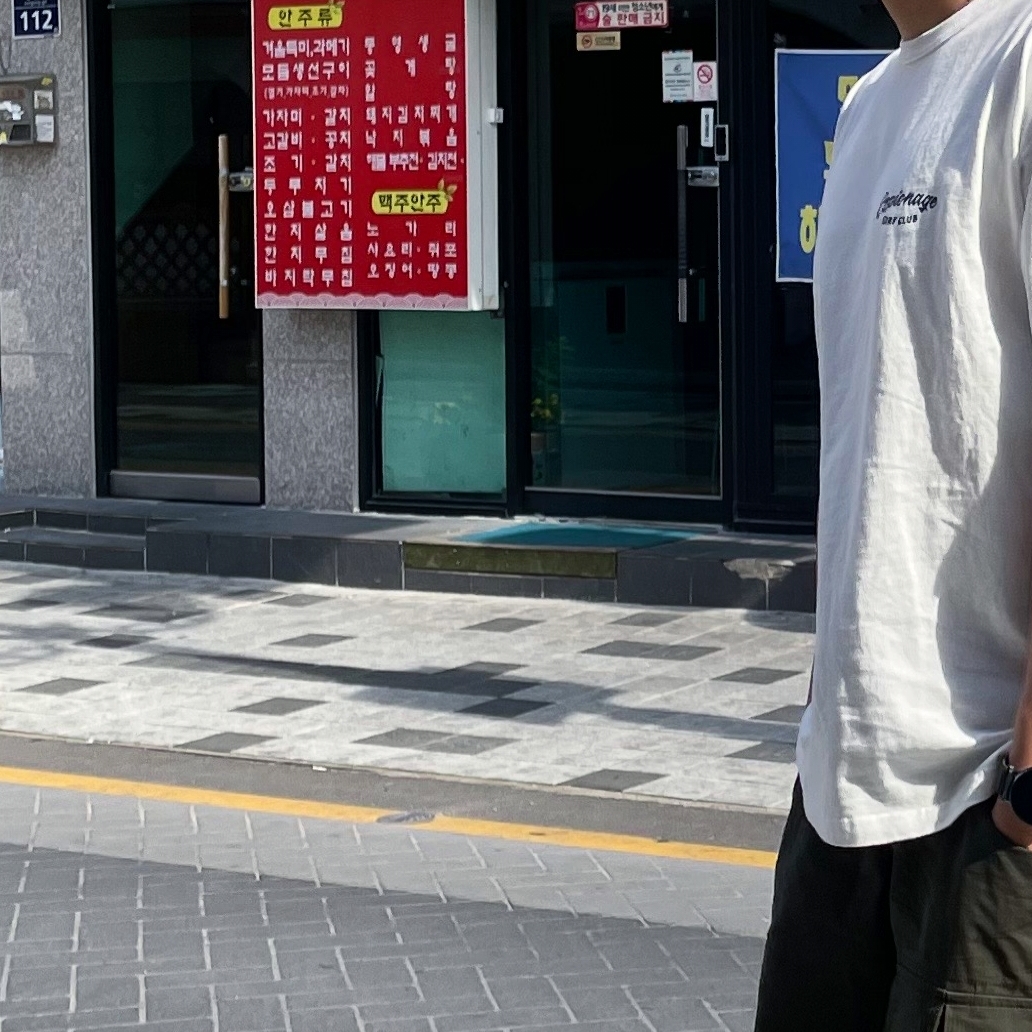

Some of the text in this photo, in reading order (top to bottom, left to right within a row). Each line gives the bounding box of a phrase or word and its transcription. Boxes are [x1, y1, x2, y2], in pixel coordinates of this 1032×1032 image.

[20, 10, 53, 31] 112
[279, 8, 332, 27] 안주류
[603, 12, 664, 26] 술 판매 금지
[378, 193, 442, 212] 맥주안주
